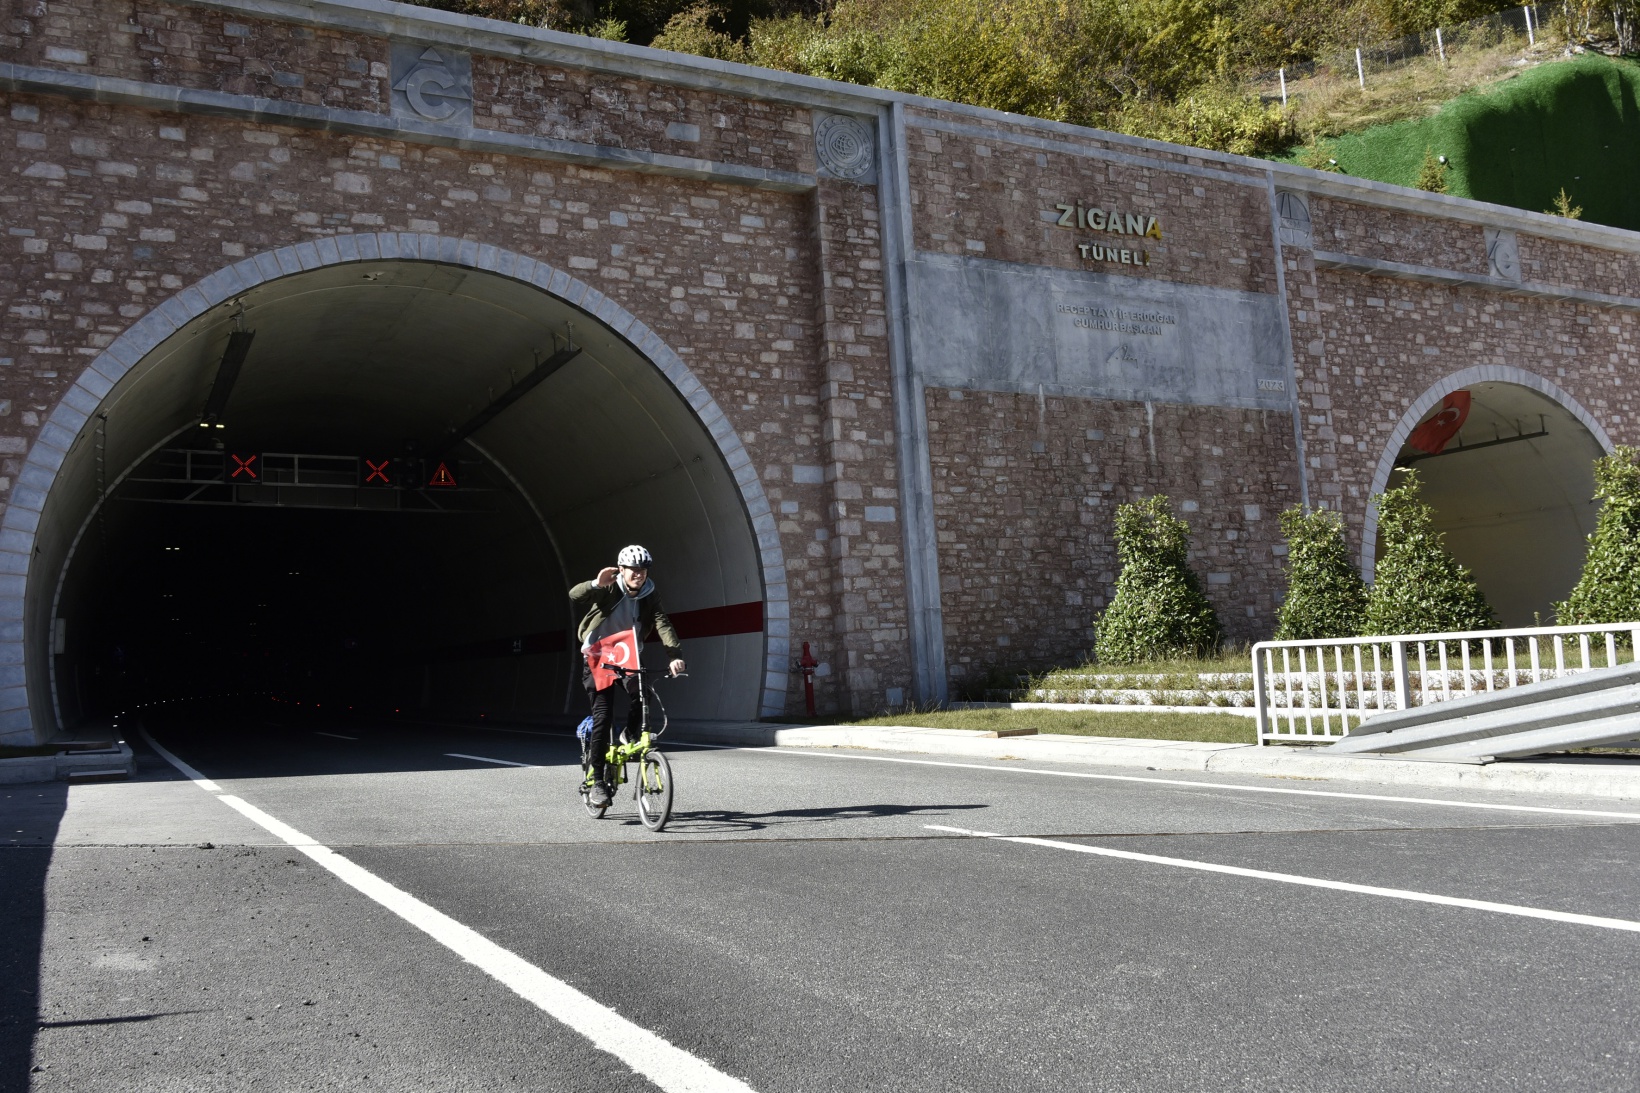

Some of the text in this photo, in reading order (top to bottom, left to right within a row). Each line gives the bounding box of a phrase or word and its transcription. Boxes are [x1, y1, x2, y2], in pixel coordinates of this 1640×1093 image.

[1056, 200, 1163, 240] ZİGANA
[1057, 304, 1090, 316] RECEP
[1130, 312, 1176, 325] ERDOĞAN
[1073, 317, 1162, 336] CUMHURBAŞKANI
